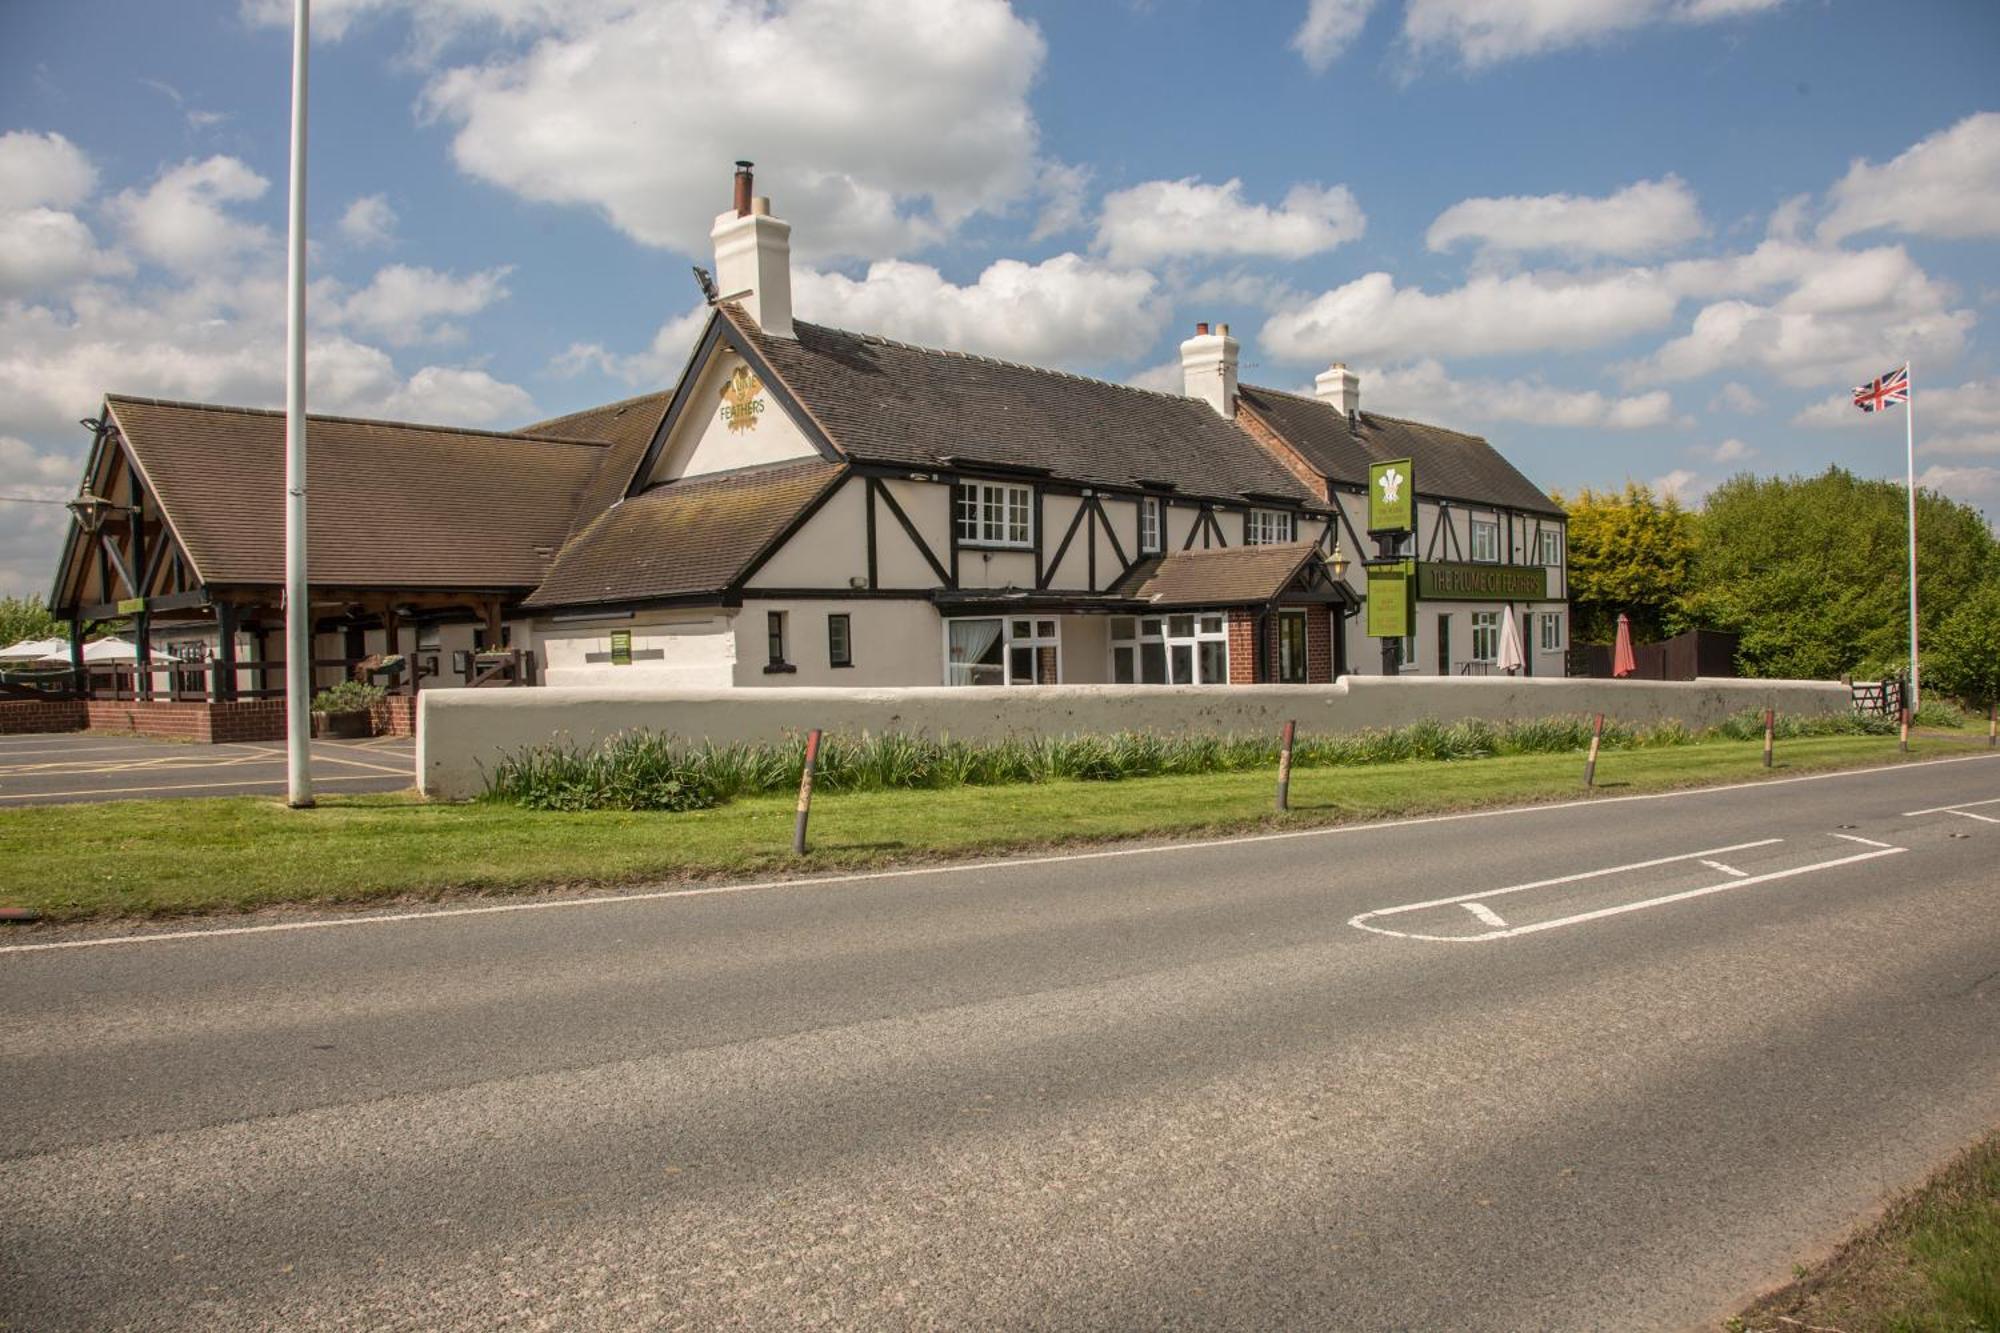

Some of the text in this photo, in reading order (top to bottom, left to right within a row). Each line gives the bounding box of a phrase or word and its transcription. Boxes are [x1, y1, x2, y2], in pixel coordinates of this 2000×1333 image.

[720, 399, 765, 421] FEATHERS
[1432, 569, 1452, 592] THE
[1453, 570, 1487, 593] PLUME
[1488, 572, 1503, 593] OF
